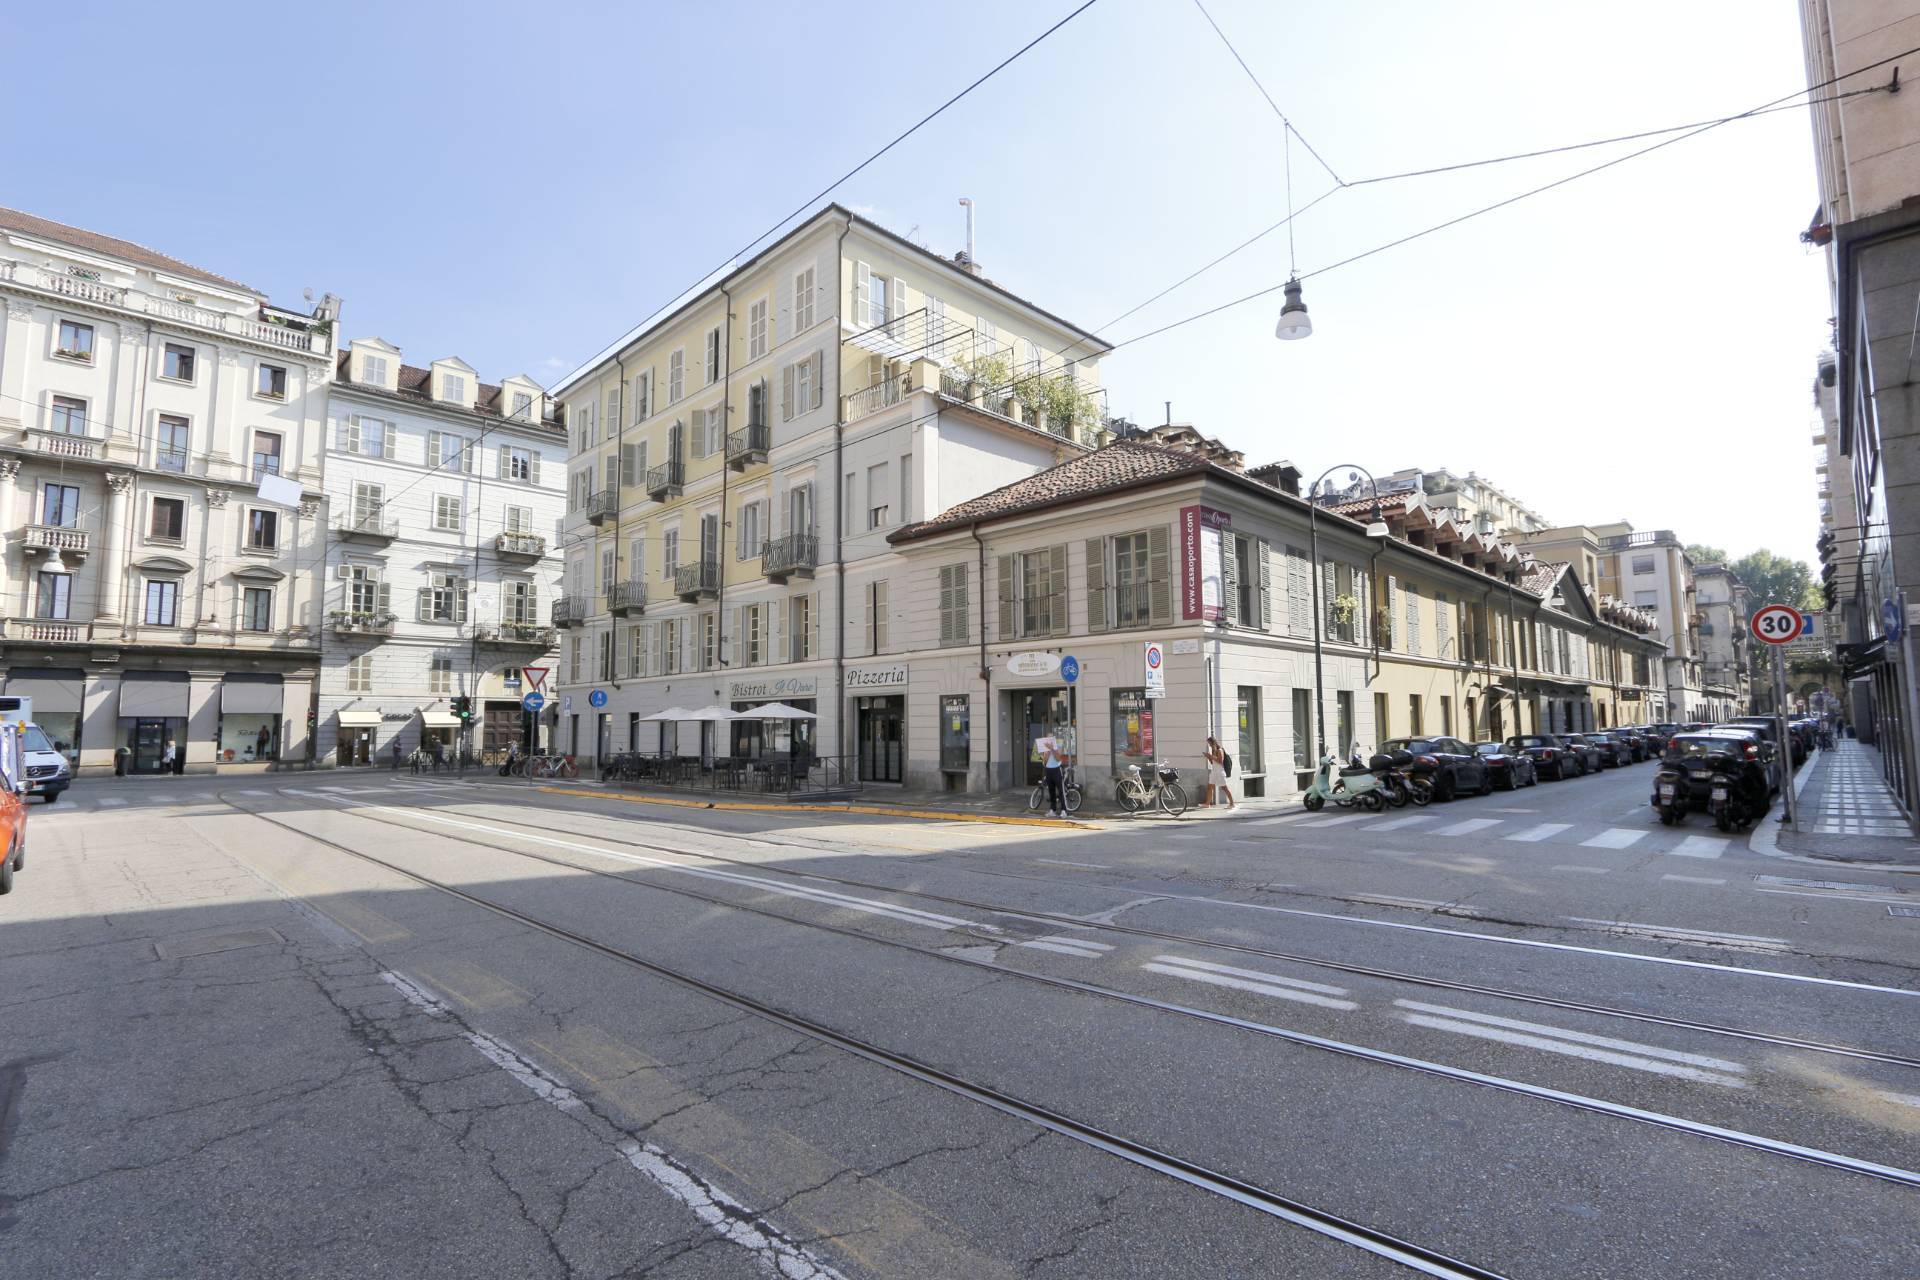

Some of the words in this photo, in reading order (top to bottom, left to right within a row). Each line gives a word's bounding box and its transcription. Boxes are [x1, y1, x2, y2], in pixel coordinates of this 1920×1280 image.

[1186, 512, 1196, 614] www.casaoporto.com
[1762, 615, 1791, 633] 30
[847, 667, 904, 685] Pizzeria
[731, 683, 766, 697] Bistrot
